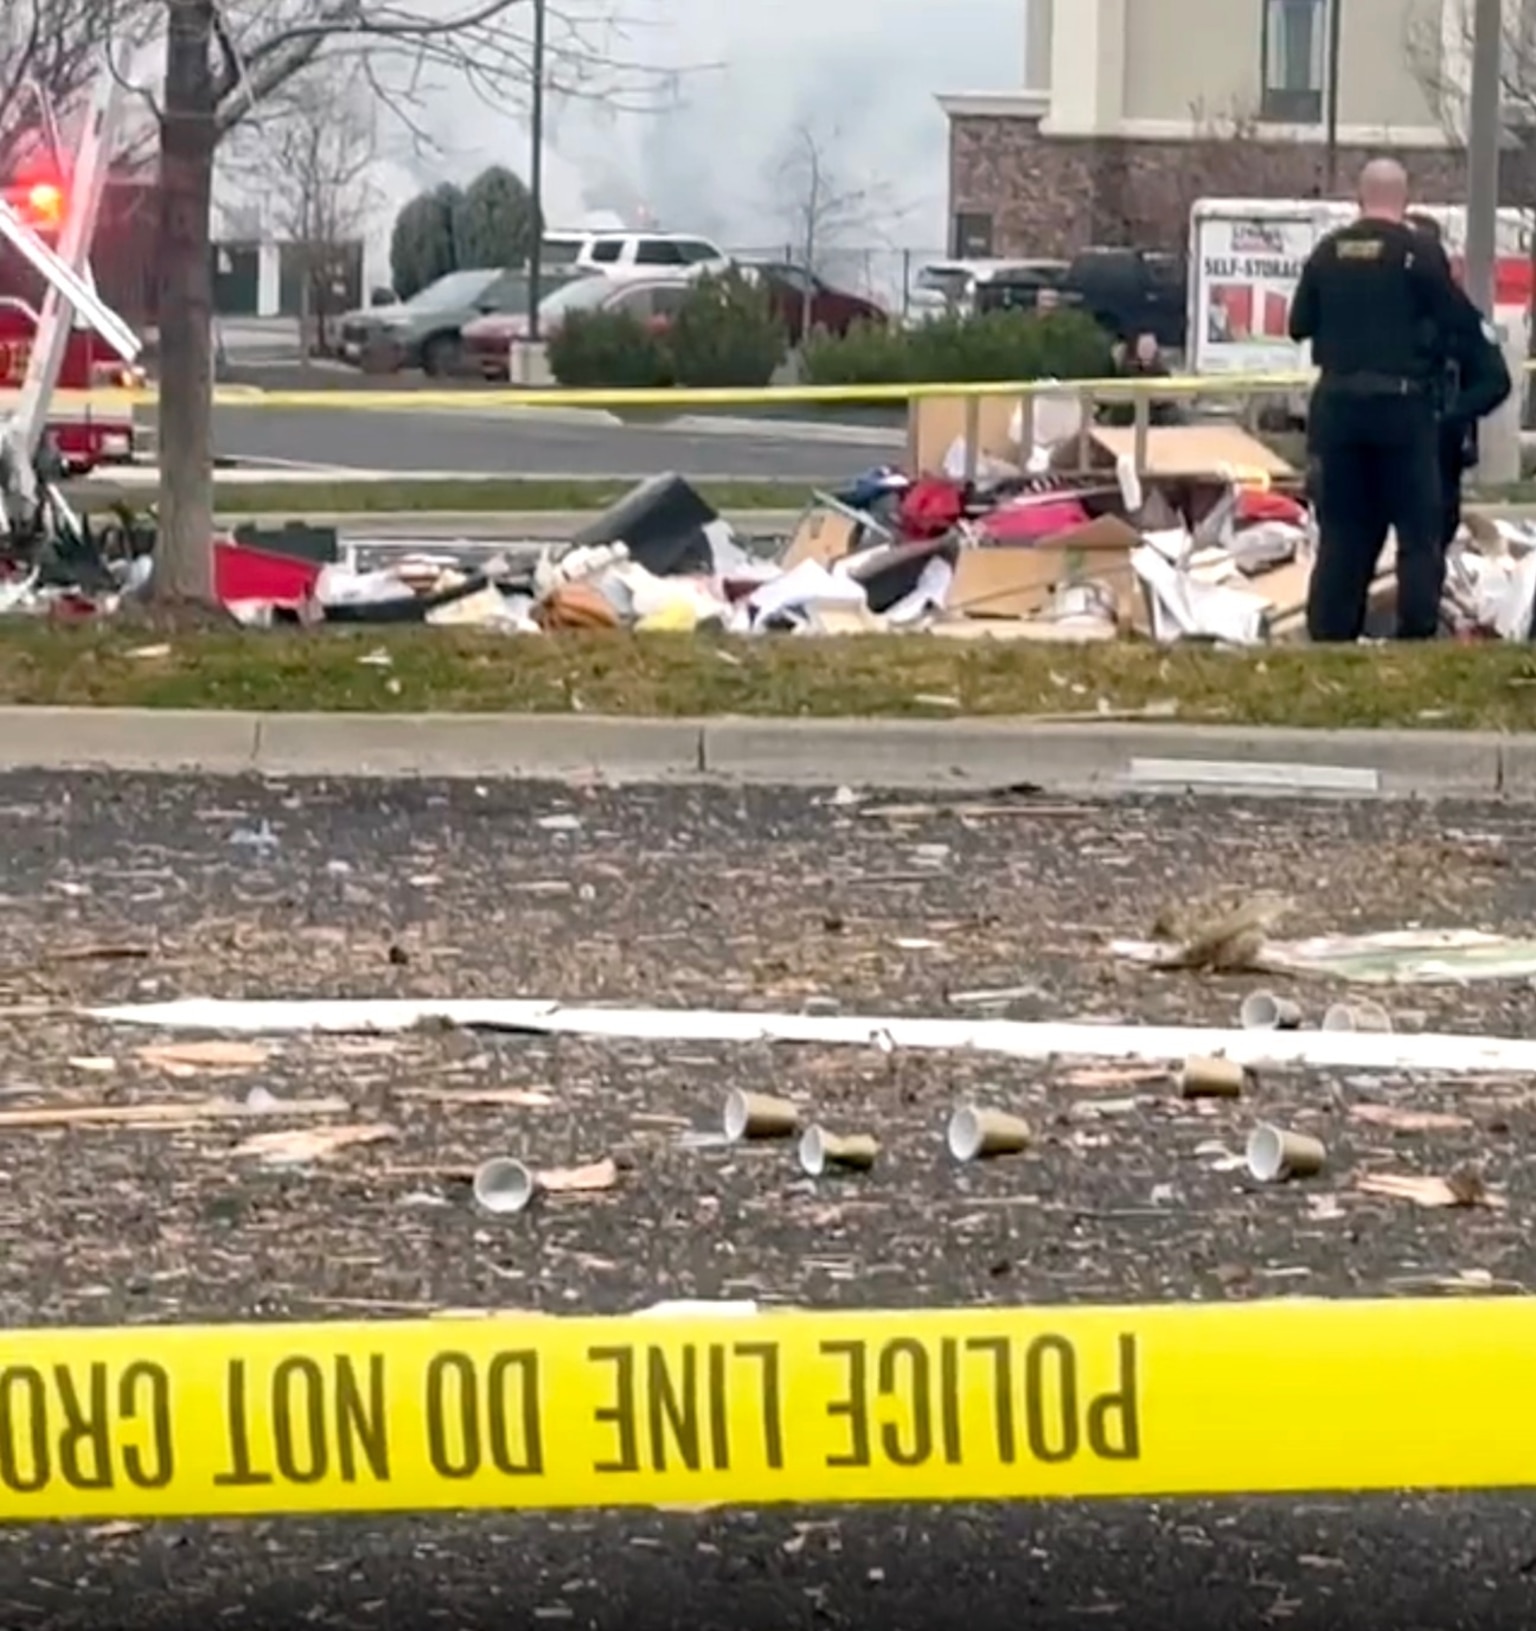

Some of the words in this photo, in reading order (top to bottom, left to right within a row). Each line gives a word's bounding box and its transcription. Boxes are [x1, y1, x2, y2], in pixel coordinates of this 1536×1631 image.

[1204, 257, 1301, 277] SELF-STORAG
[212, 1353, 391, 1487] NOT
[426, 1349, 545, 1481] DO
[588, 1342, 784, 1474] LINE
[819, 1333, 1141, 1468] POLICE
